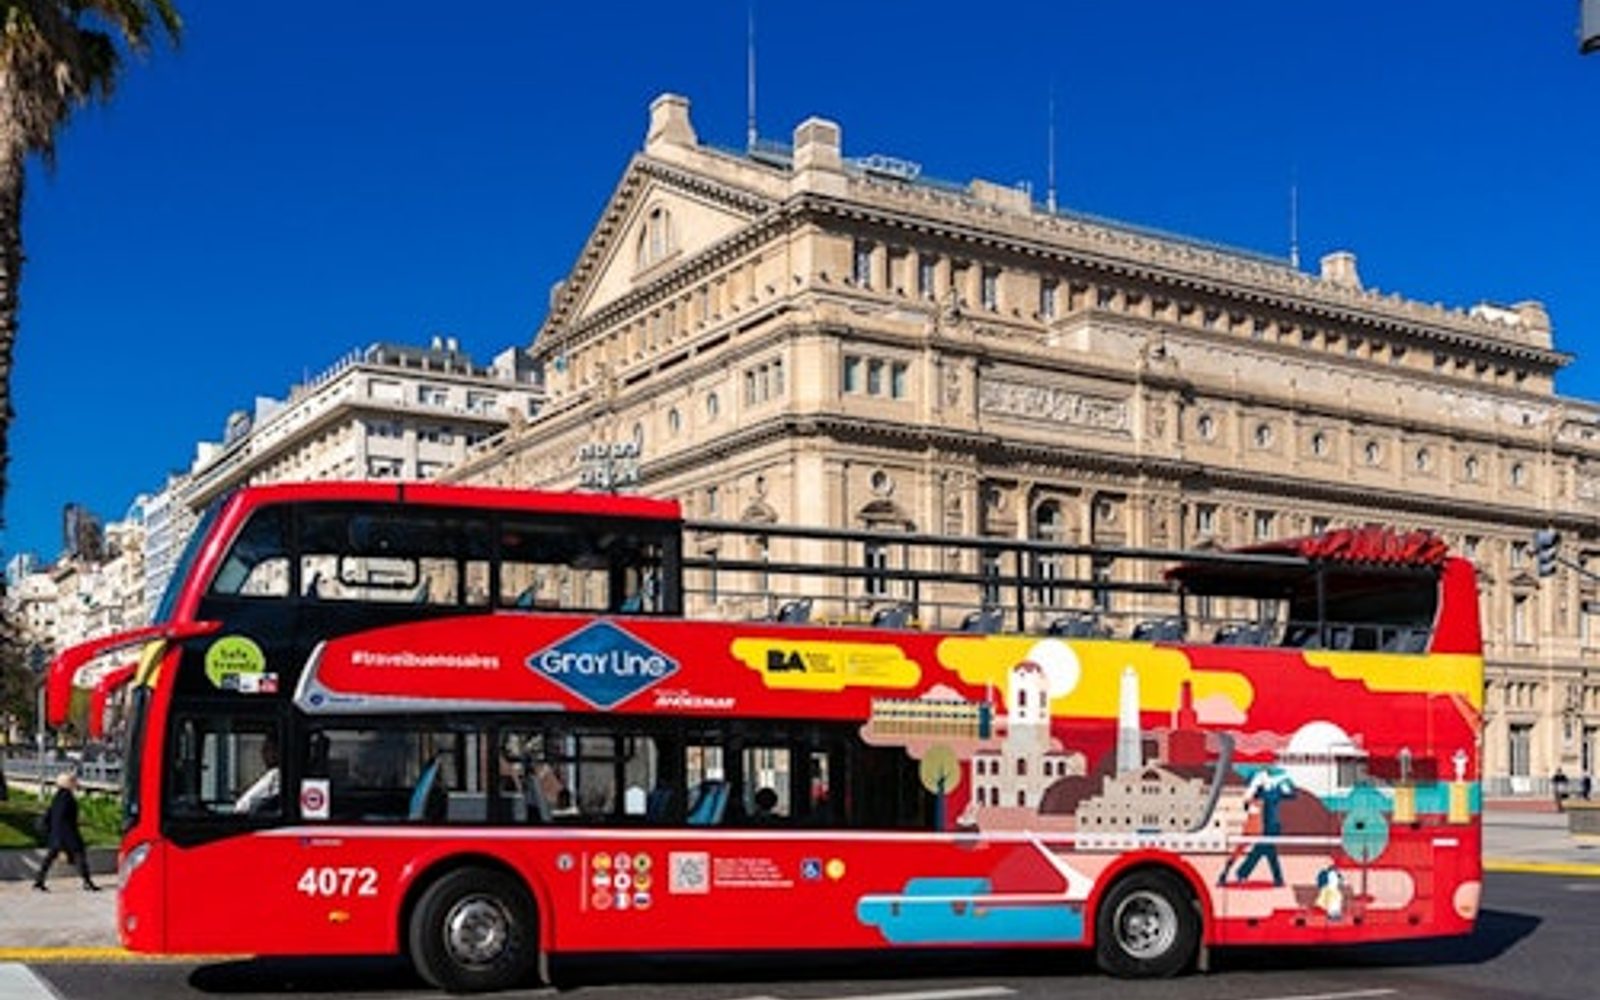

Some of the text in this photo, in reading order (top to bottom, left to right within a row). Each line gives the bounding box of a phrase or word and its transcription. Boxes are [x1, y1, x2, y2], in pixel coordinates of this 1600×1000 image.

[351, 651, 500, 669] #travelbuenosaires
[541, 650, 666, 677] Gray Line
[767, 650, 806, 672] BA
[297, 867, 378, 896] 4072
